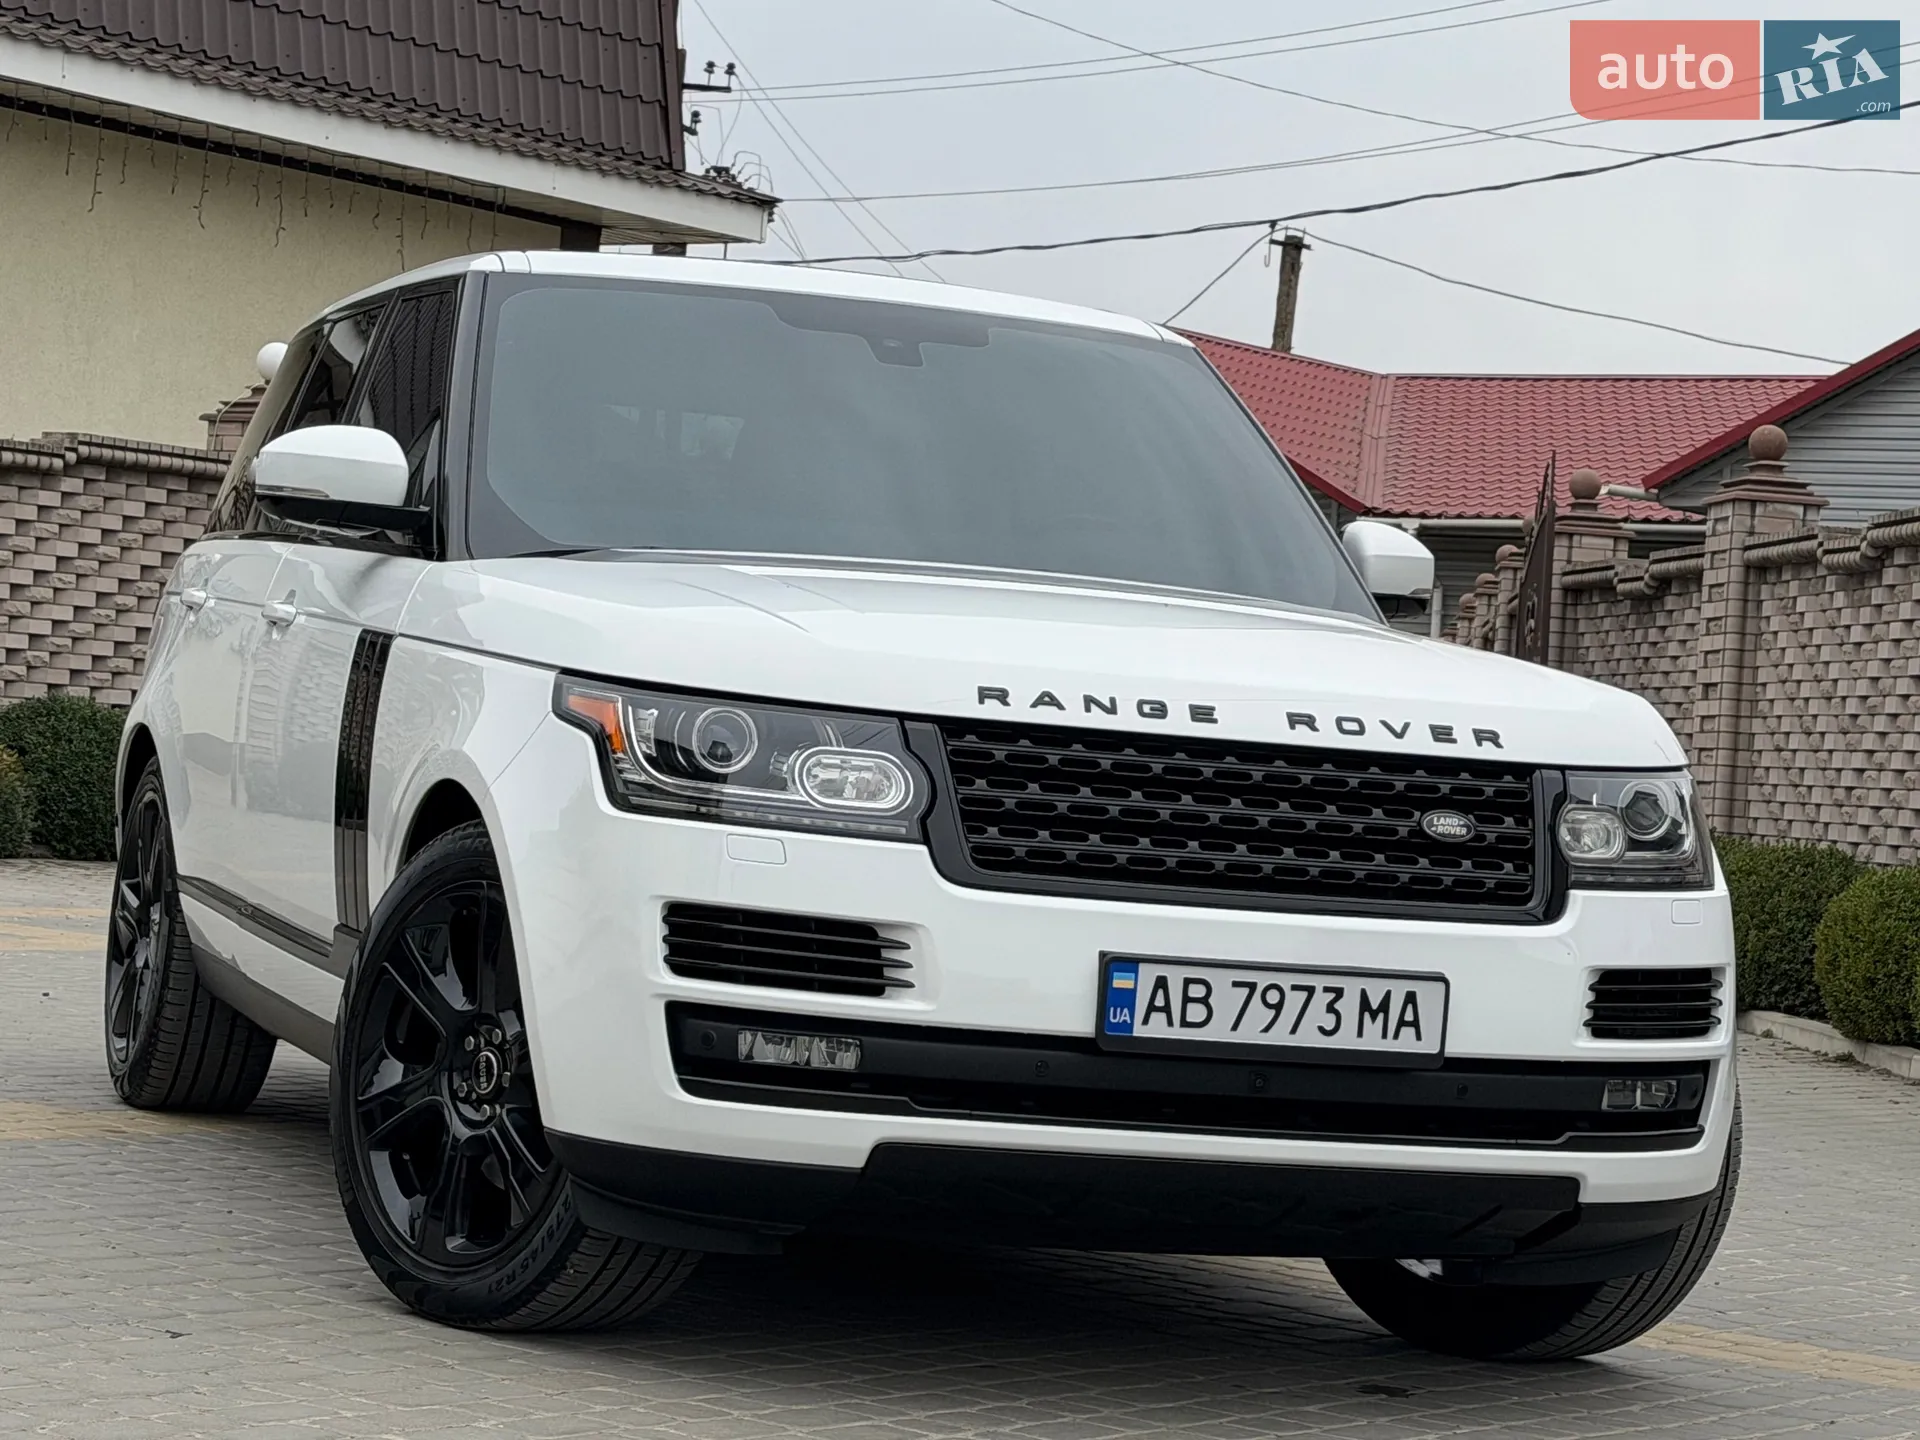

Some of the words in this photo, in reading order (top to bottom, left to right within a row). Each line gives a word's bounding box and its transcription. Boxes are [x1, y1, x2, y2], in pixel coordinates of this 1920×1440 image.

[976, 684, 1219, 725] RANGE
[1285, 710, 1505, 750] ROVER
[1432, 816, 1459, 826] LAND
[1436, 825, 1468, 836] ROVER
[1109, 1005, 1132, 1025] UA
[1140, 974, 1214, 1029] AB
[1229, 979, 1346, 1038] 7973
[1356, 986, 1424, 1042] MA
